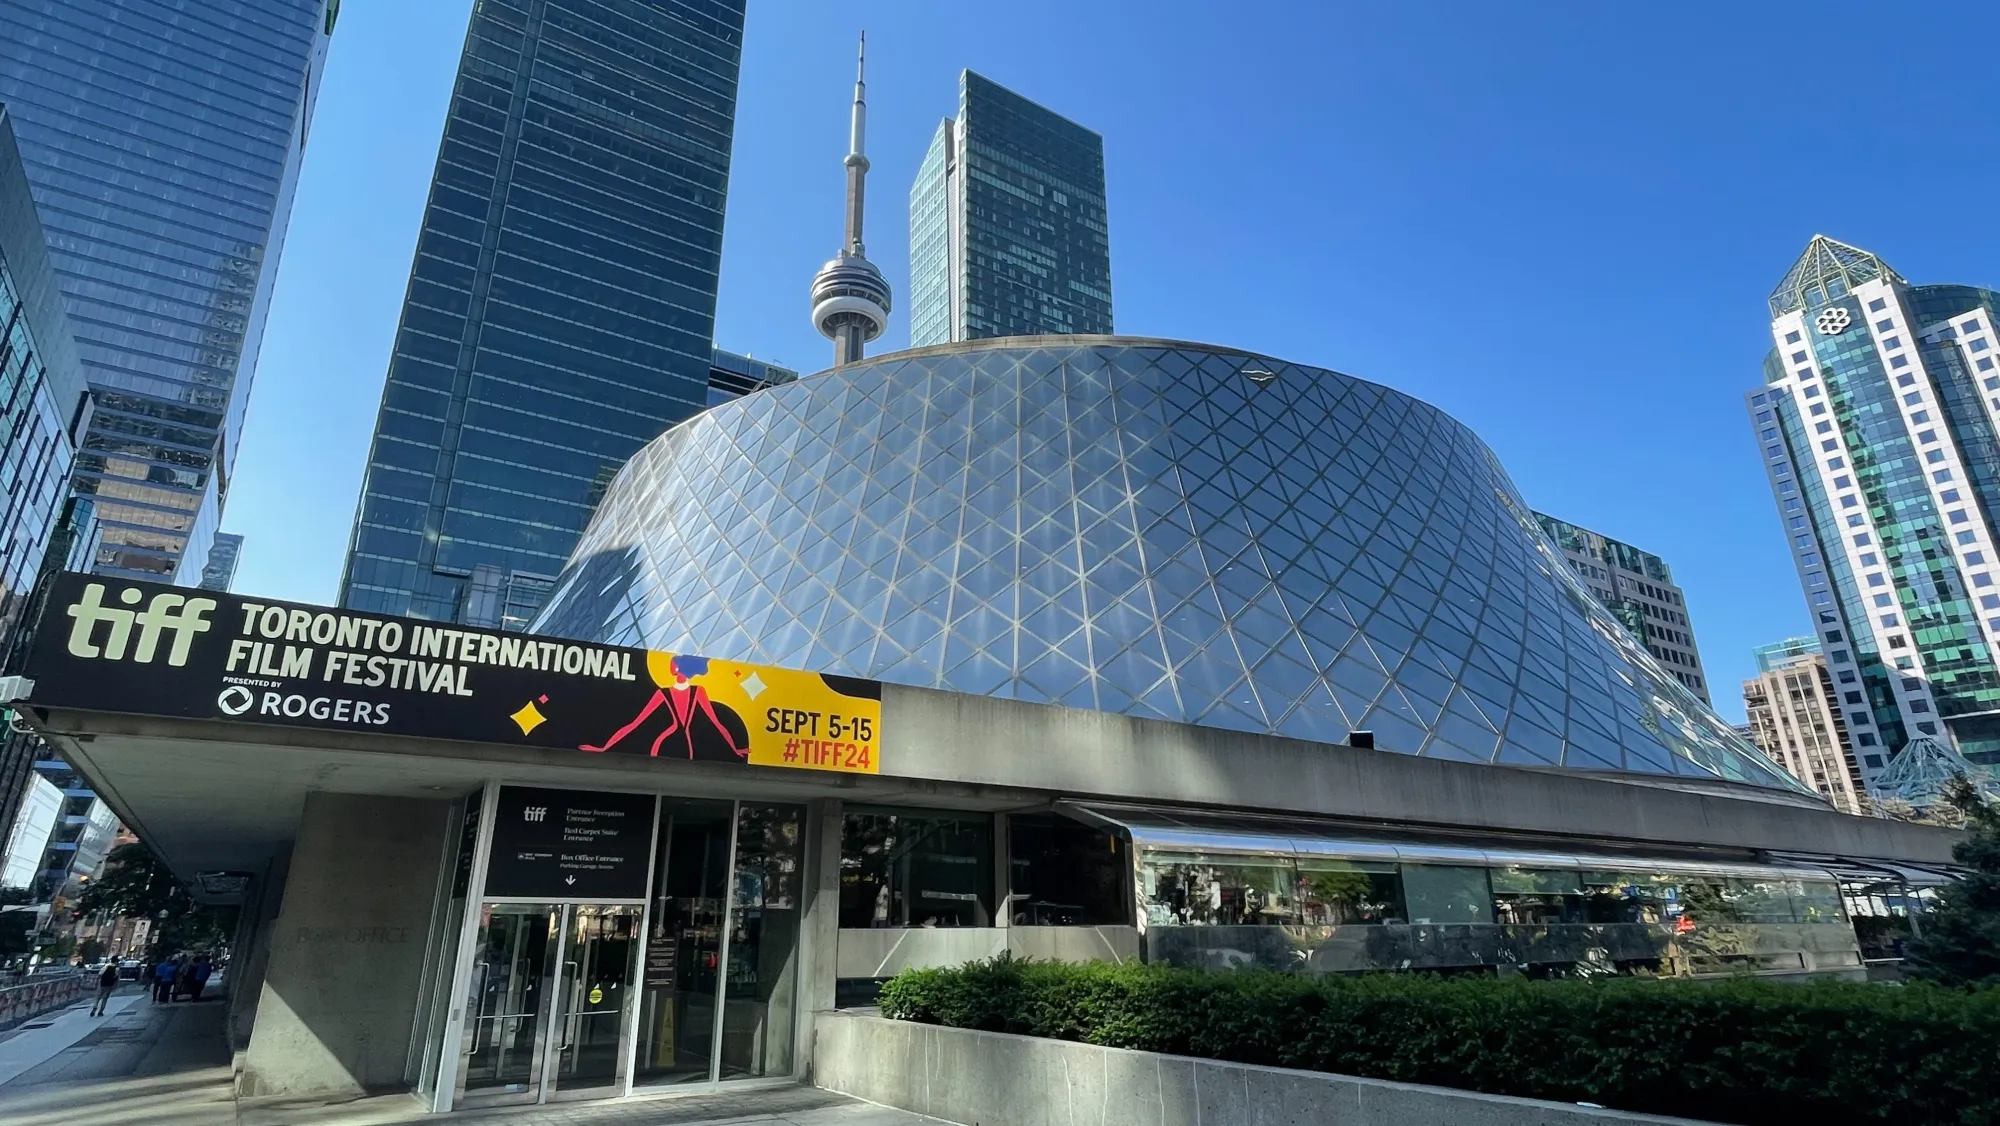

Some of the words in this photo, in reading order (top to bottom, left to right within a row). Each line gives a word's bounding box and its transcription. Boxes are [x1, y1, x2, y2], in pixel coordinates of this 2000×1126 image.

[67, 583, 217, 667] tiff
[241, 602, 403, 653] TORONTO
[409, 625, 636, 682] INTERNATIONAL
[223, 676, 269, 687] PRESENTED
[270, 680, 282, 688] BY
[226, 639, 314, 680] FILM
[323, 650, 473, 697] FESTIVAL
[260, 691, 391, 725] ROGERS
[765, 707, 821, 736] SEPT
[828, 714, 872, 742] 5-15
[783, 737, 870, 769] #TIFF24
[523, 806, 548, 822] tiff
[563, 834, 594, 842] Entrance
[578, 828, 600, 836] Carpet
[560, 853, 574, 861] Box
